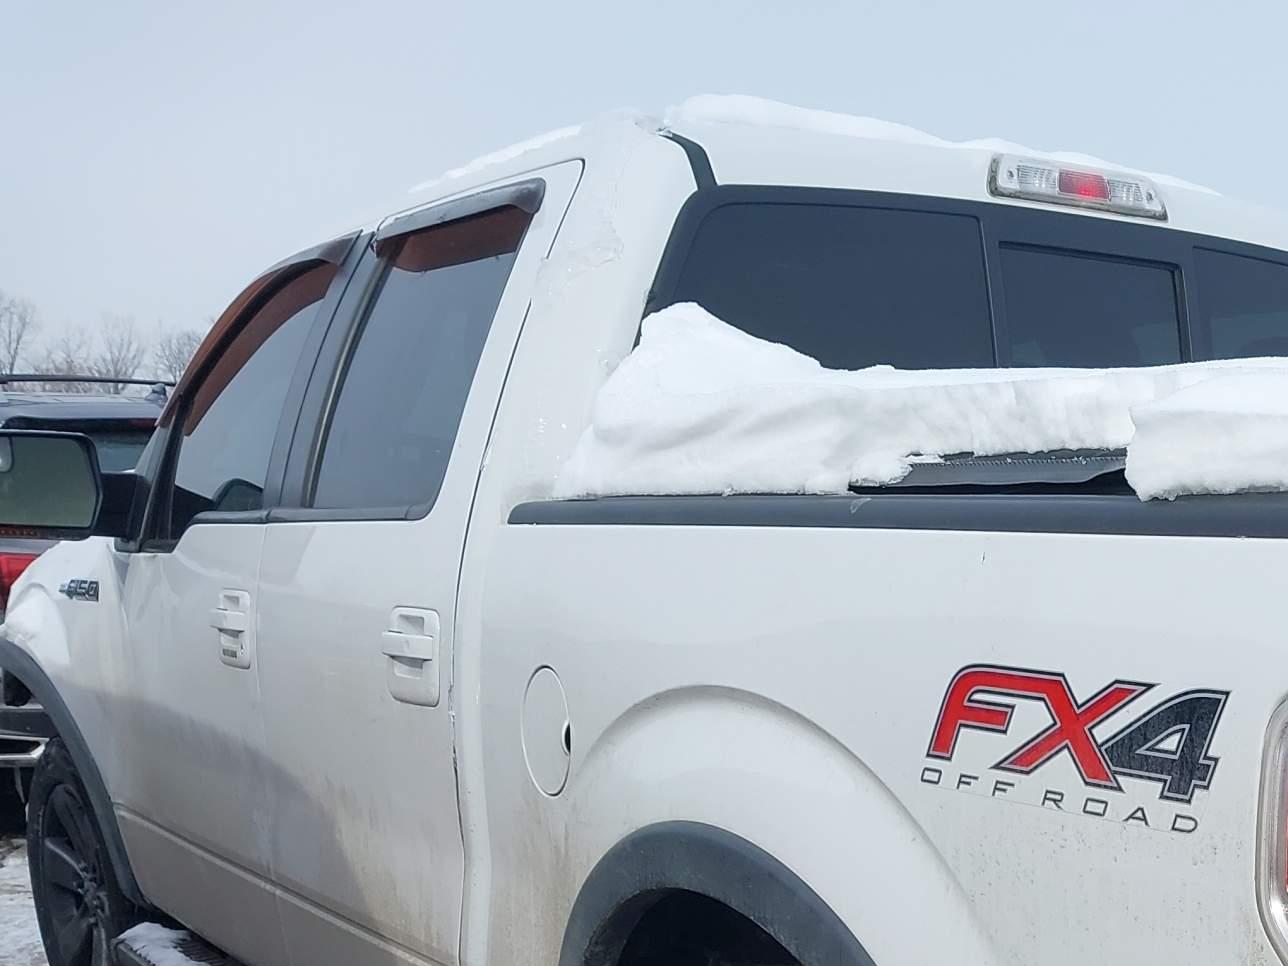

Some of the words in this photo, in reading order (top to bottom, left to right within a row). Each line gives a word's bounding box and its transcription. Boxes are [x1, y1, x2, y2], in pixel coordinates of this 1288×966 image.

[925, 663, 1232, 804] FX4
[920, 766, 1015, 797] OFF
[1041, 789, 1199, 834] ROAD
